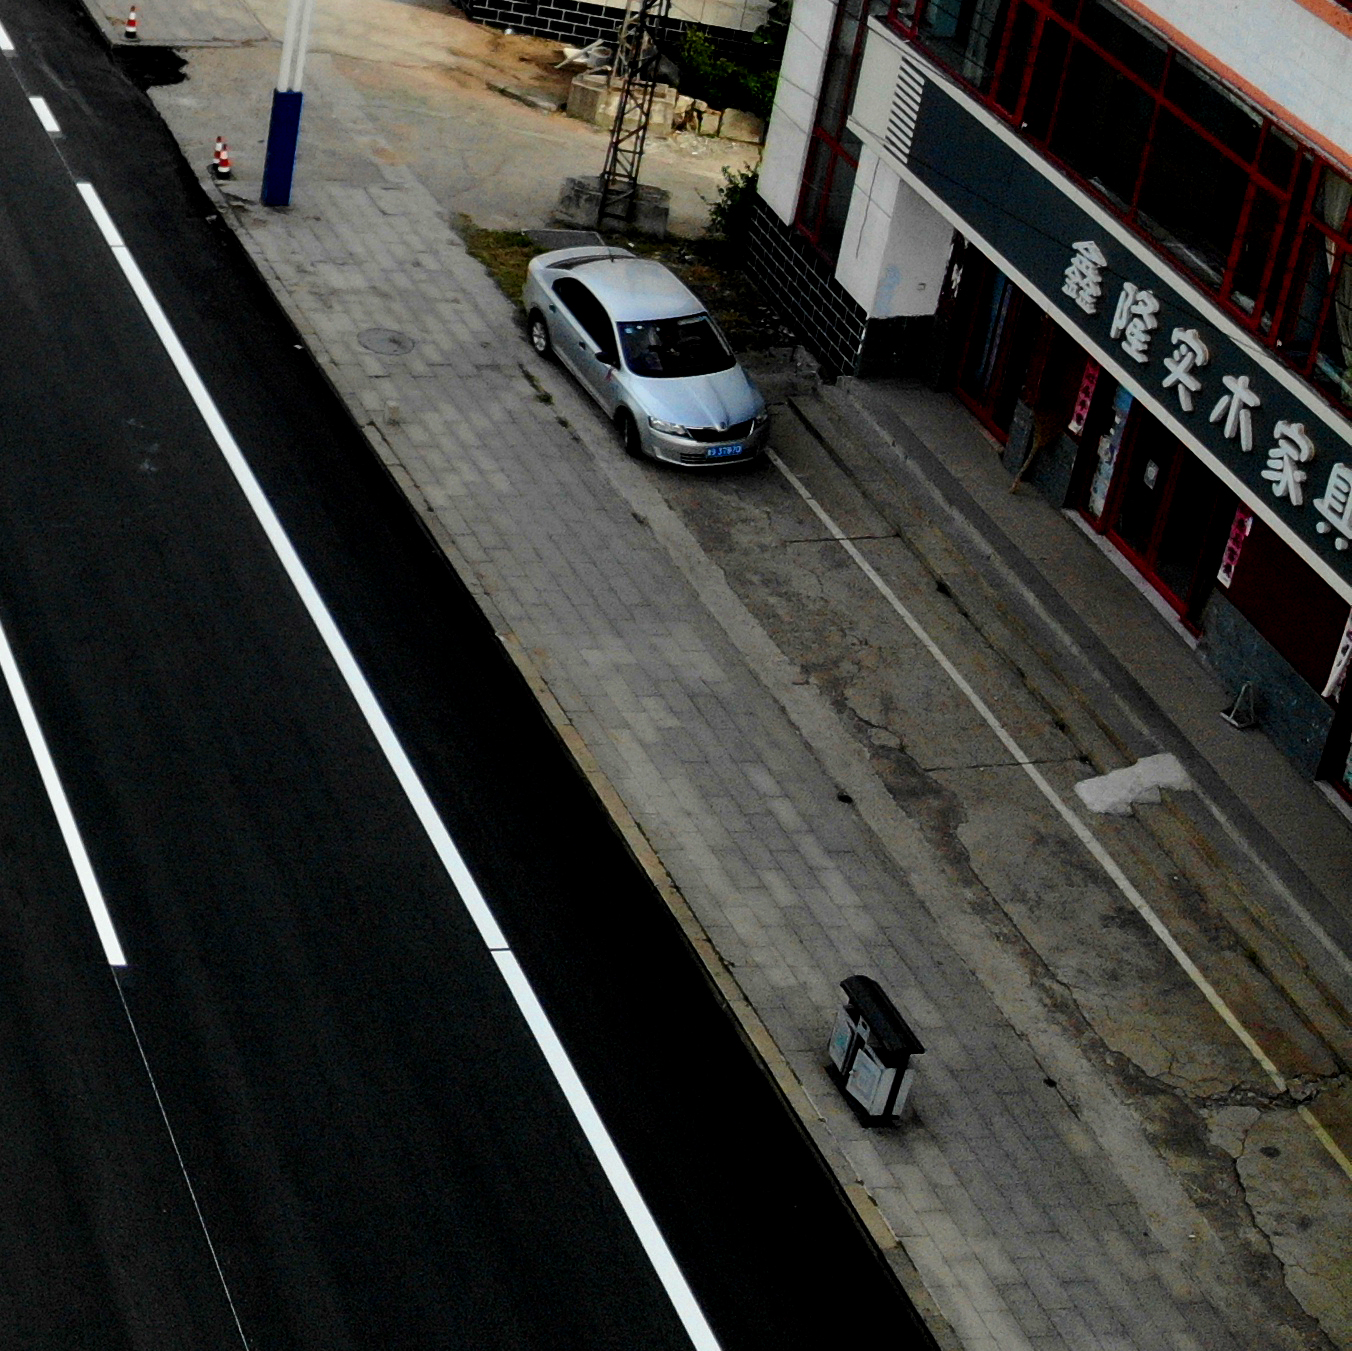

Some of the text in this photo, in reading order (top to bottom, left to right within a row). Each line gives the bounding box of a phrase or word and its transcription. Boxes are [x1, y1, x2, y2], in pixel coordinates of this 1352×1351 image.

[1061, 240, 1352, 551] 鑫隆实木家具
